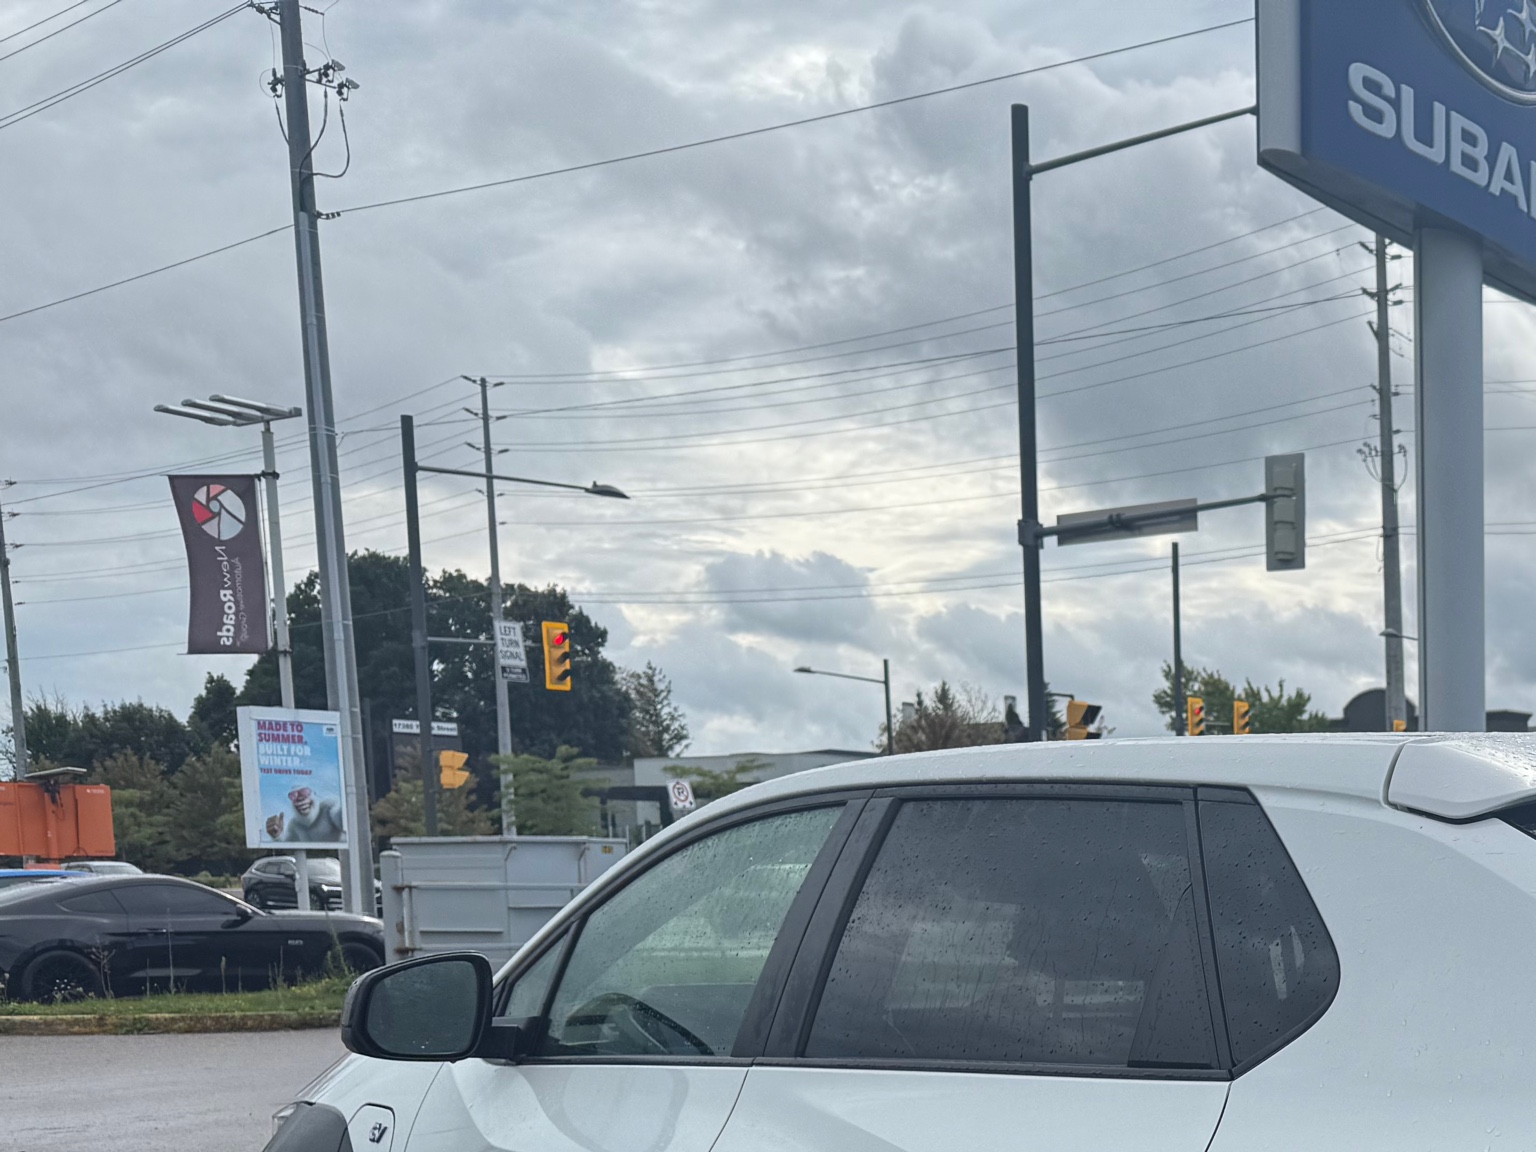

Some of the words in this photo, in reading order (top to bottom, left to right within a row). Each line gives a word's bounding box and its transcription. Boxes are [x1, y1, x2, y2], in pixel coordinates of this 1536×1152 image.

[500, 626, 516, 637] LEFT
[500, 637, 520, 648] TURN
[257, 720, 288, 732] MADE
[290, 722, 304, 733] TO
[257, 732, 308, 745] SUMMER.
[259, 743, 288, 755] BUILT
[290, 745, 311, 756] FOR
[259, 755, 304, 767] WINTER.
